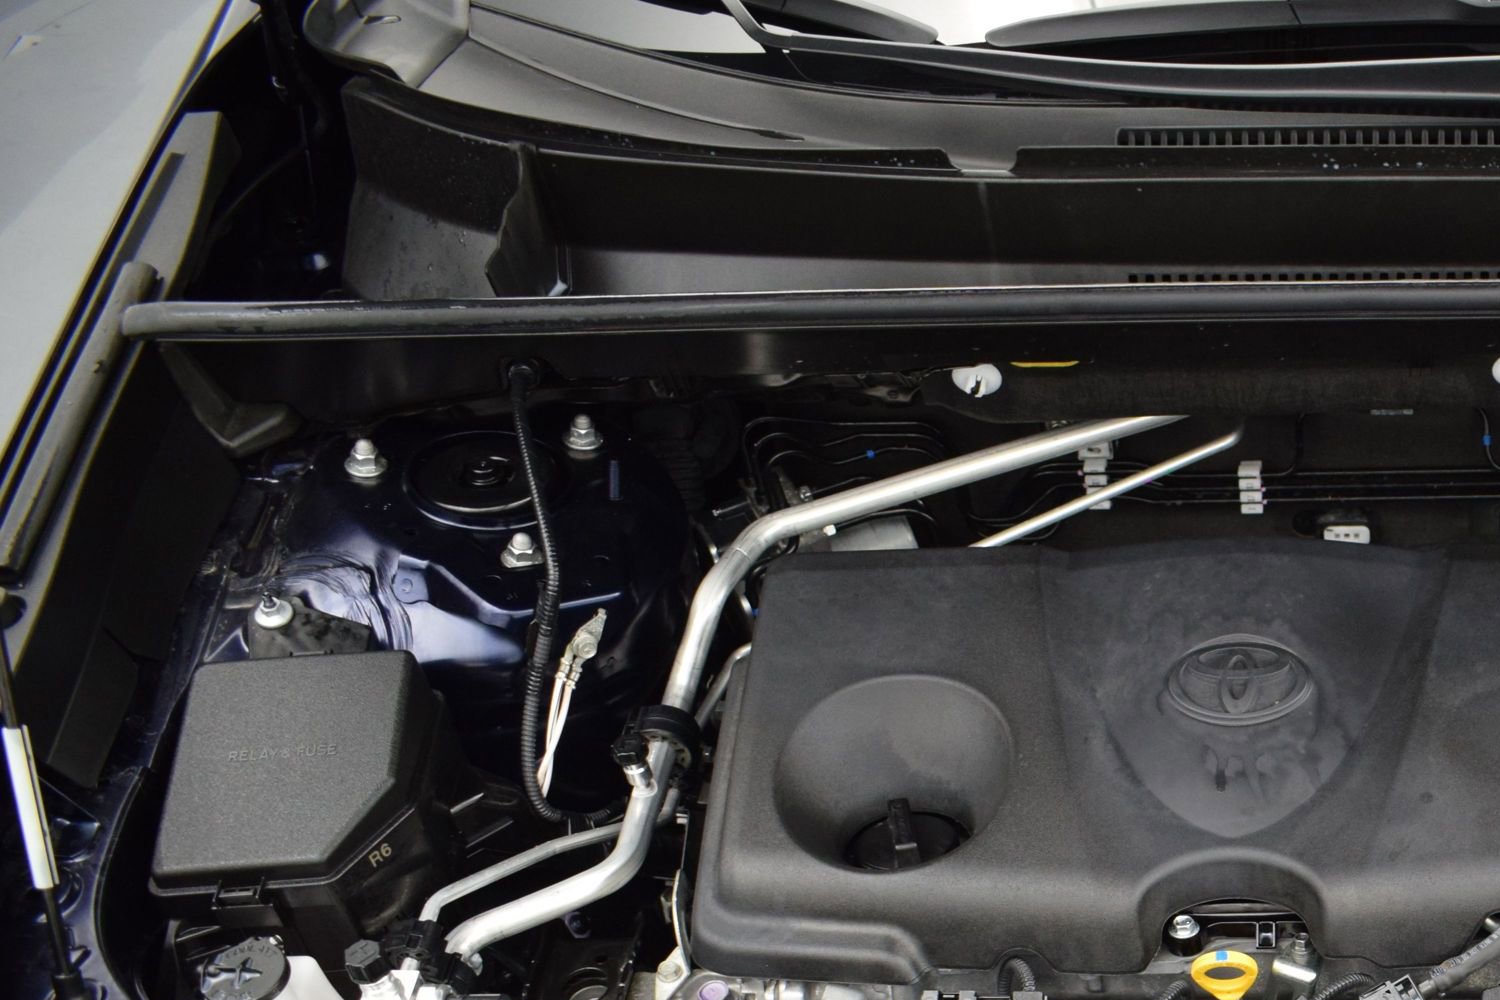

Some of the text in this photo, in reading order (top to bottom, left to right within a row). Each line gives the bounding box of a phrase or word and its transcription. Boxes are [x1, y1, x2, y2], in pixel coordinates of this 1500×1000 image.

[229, 743, 338, 763] RELAY & FUSE
[367, 842, 393, 868] R6
